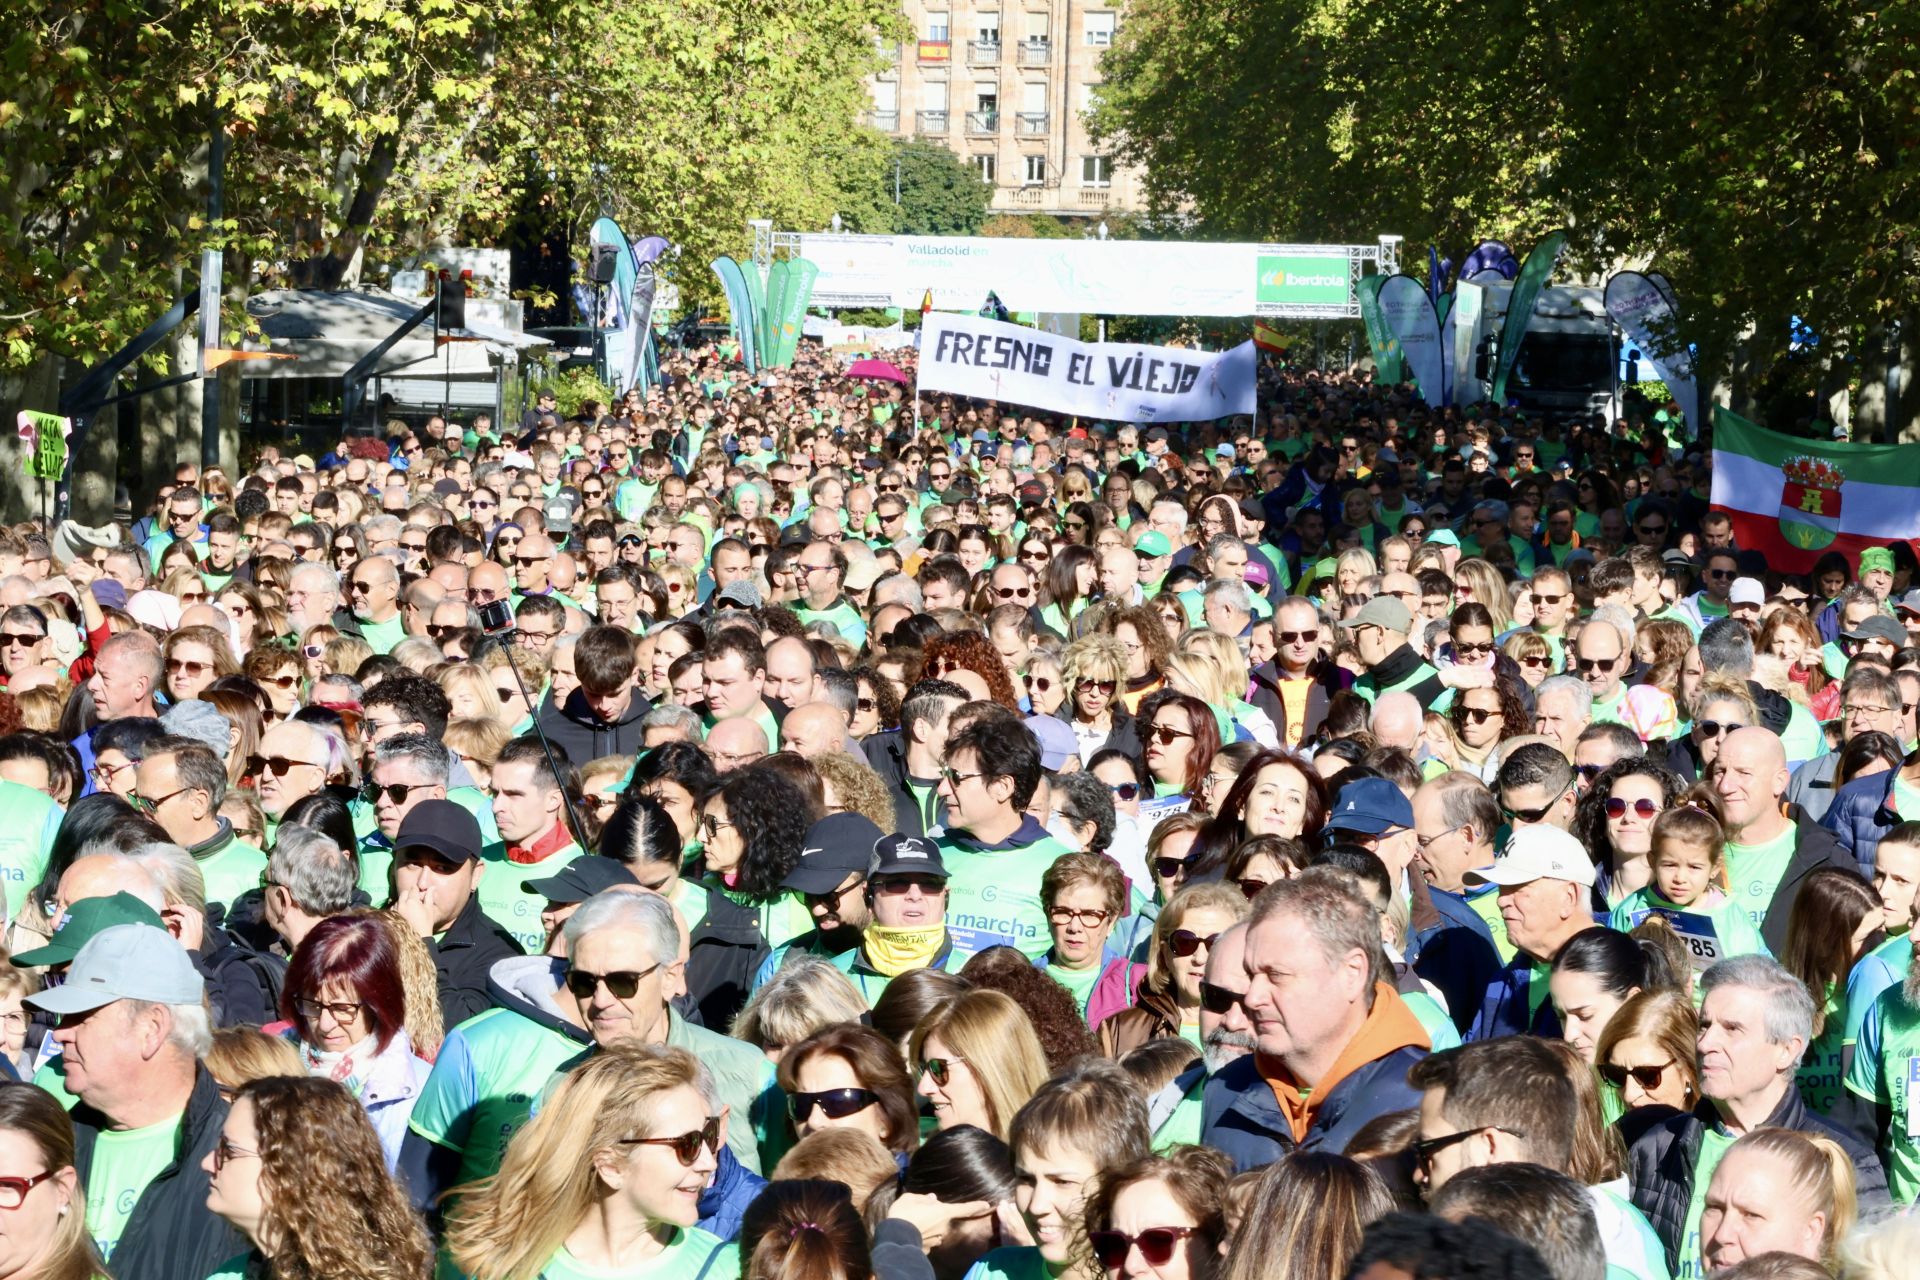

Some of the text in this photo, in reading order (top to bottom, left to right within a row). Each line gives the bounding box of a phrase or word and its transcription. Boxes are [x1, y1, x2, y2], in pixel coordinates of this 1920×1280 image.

[907, 243, 970, 256] Valladolid
[1286, 272, 1345, 287] Iberdrola
[935, 329, 1053, 377] FRESNO
[1067, 352, 1095, 386] EL
[955, 912, 1037, 938] marcha
